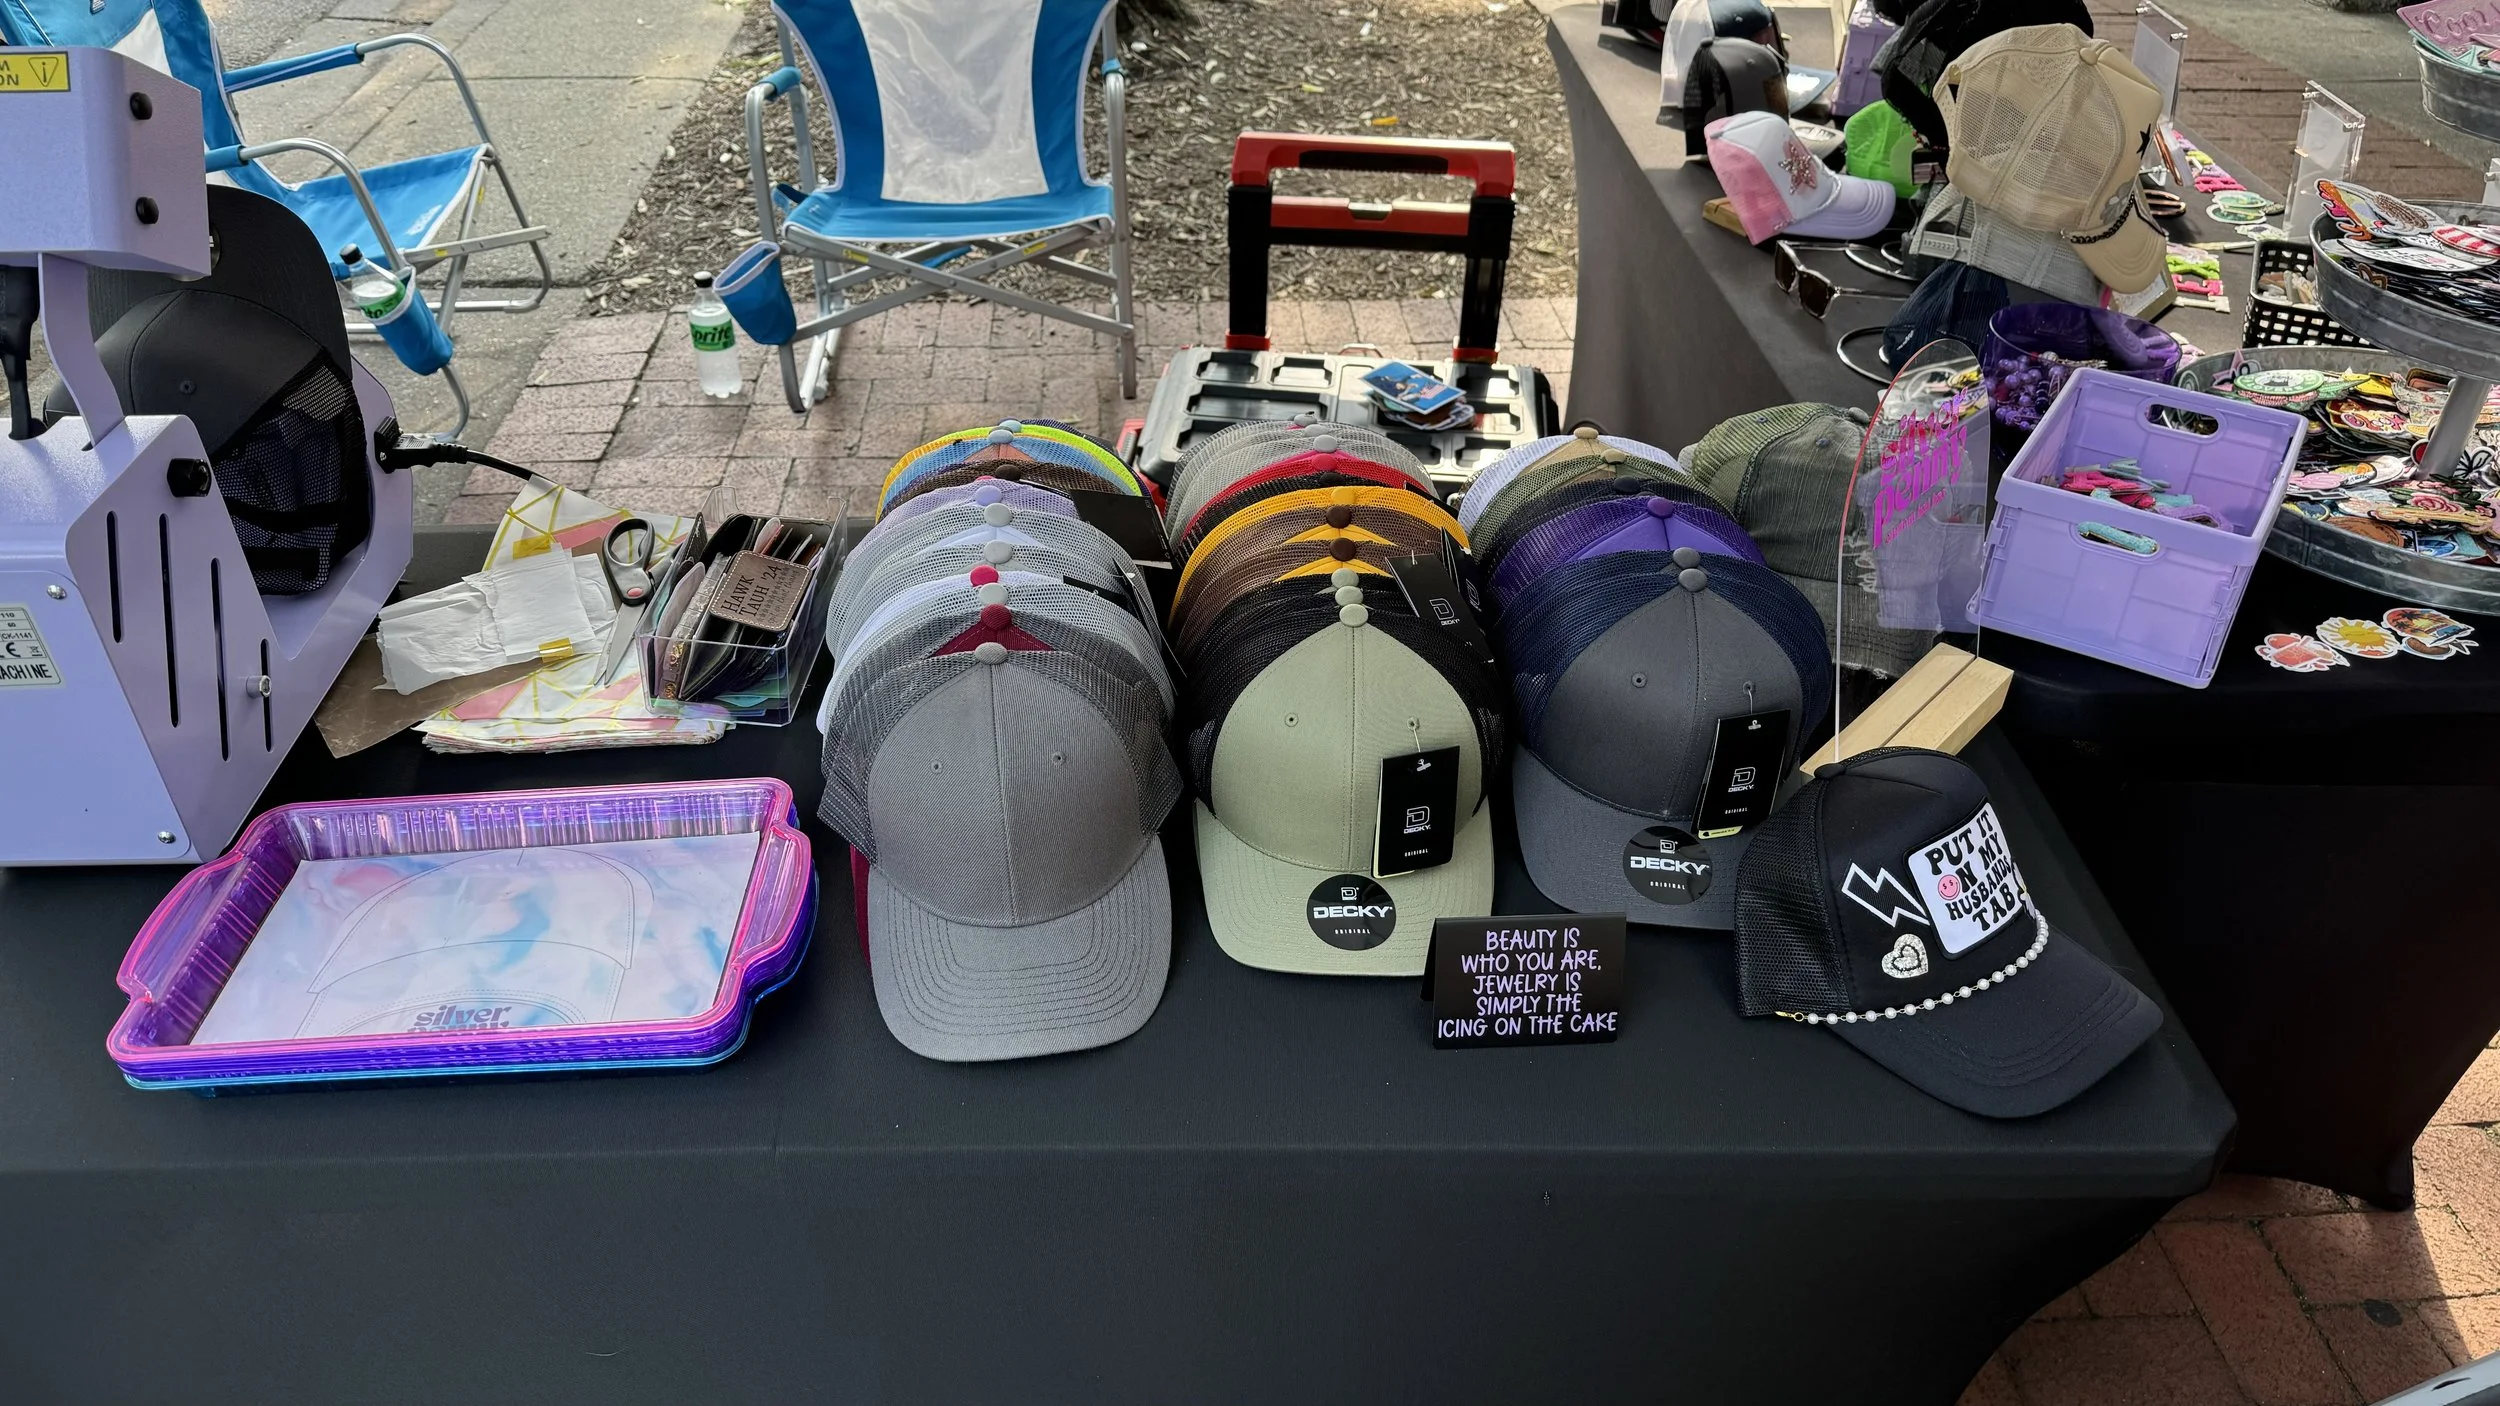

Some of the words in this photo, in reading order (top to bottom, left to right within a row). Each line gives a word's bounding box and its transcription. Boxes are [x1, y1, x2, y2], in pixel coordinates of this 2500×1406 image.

[1873, 425, 1968, 550] penny
[721, 575, 754, 613] HAWK
[739, 585, 770, 616] TAUH
[0, 664, 52, 679] ACHINE
[1924, 828, 1975, 875] PUT
[1976, 810, 1993, 838] IT
[1978, 832, 2003, 871] MY
[1630, 856, 1707, 876] DECKY
[1945, 855, 2012, 921] HUSBANDS
[1313, 905, 1391, 919] DECKY
[1972, 883, 2016, 931] TAB
[1486, 929, 1557, 951] BEAUTY
[1563, 927, 1580, 949] IS
[1461, 953, 1509, 974] WHO
[1515, 952, 1554, 972] YOU
[1560, 949, 1601, 971] ARE,
[1472, 973, 1558, 995] JEWELRY
[1565, 971, 1582, 992] IS
[414, 1005, 512, 1027] silver
[1476, 995, 1541, 1016] SIMPLY
[1546, 993, 1583, 1013] THE
[1438, 1019, 1488, 1039] ICING
[1494, 1017, 1521, 1036] ON
[1528, 1014, 1564, 1035] THE
[1570, 1011, 1618, 1033] CAKE
